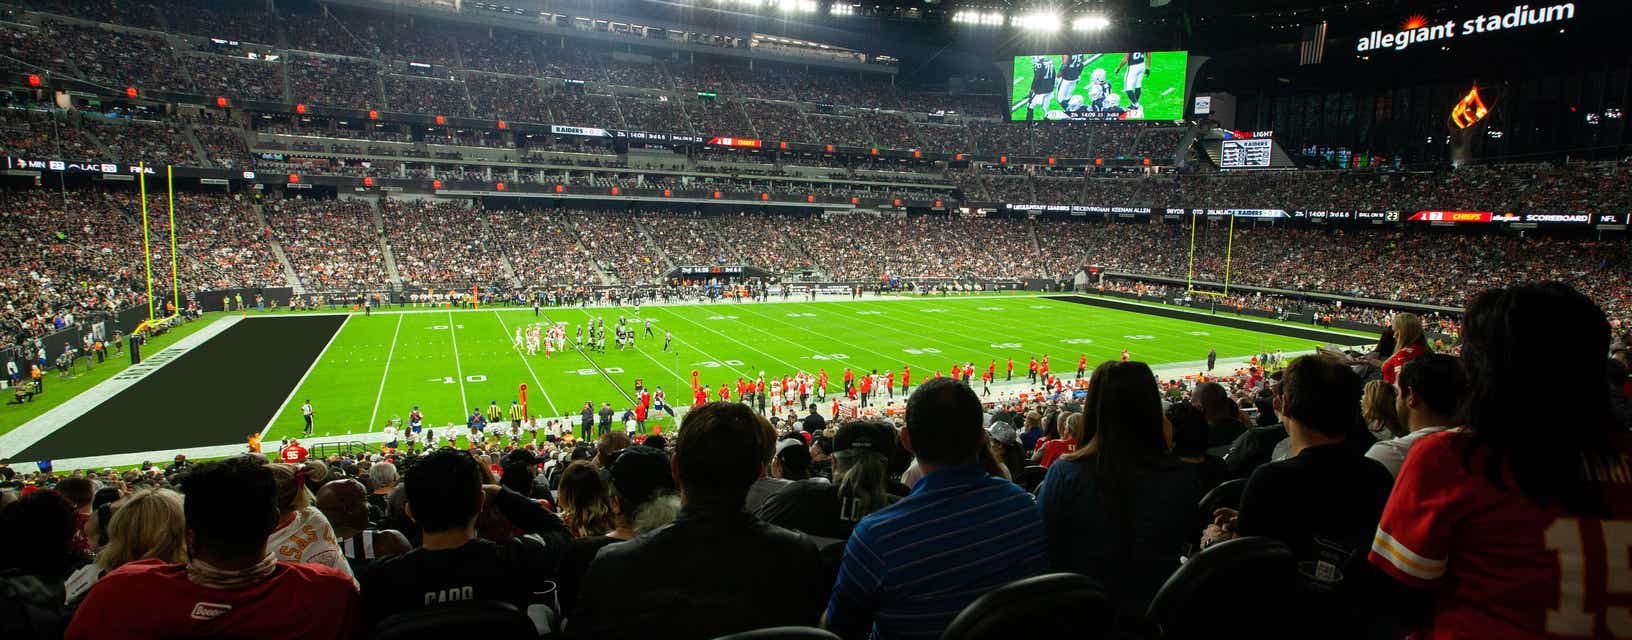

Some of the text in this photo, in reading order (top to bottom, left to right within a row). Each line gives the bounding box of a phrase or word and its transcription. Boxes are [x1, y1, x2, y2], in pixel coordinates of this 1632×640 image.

[1357, 2, 1576, 51] allegiant stadium
[556, 126, 584, 134] RAIDERS
[1253, 130, 1273, 138] LIGHT
[29, 160, 46, 169] MIN
[80, 163, 100, 171] LAC
[1387, 212, 1398, 220] 23
[1526, 214, 1588, 222] SCOREBOARD
[1600, 215, 1617, 223] NFL
[287, 450, 299, 460] 95
